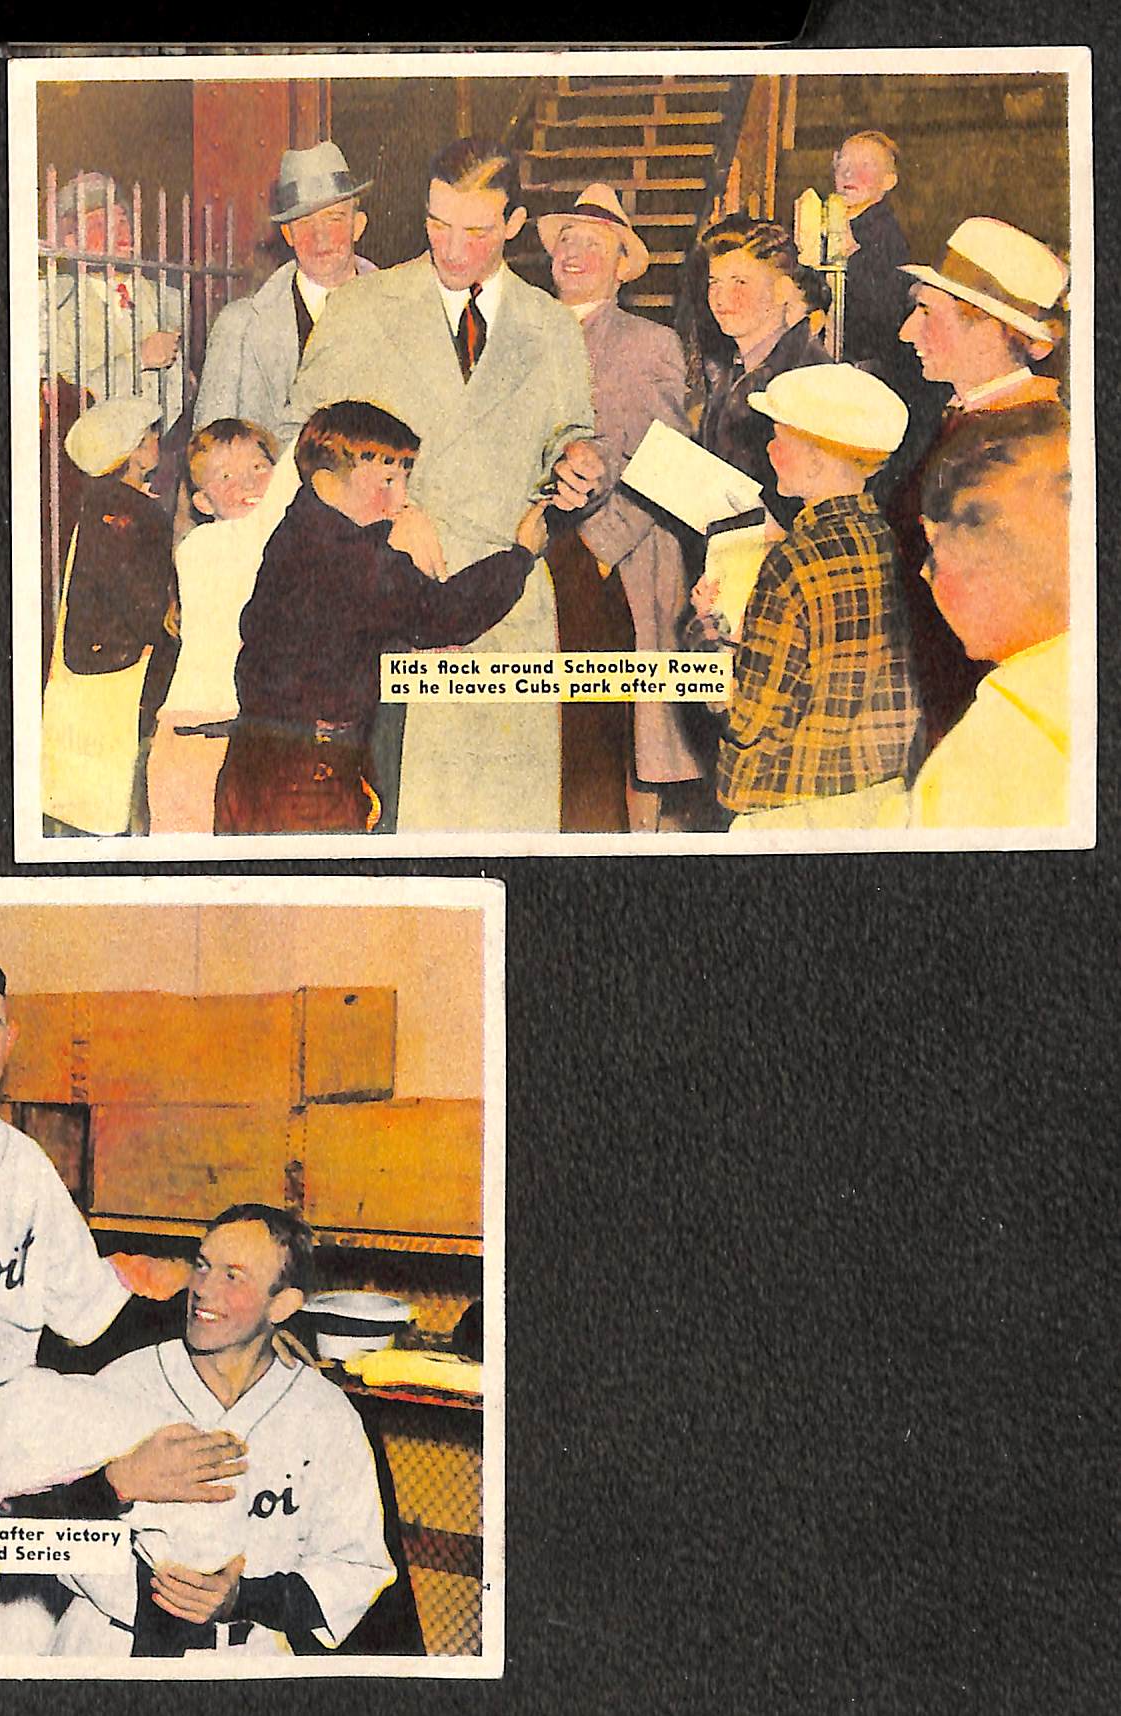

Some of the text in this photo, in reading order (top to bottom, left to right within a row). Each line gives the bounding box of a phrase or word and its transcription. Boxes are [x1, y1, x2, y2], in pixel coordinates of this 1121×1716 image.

[390, 659, 725, 677] Kids flock around Schoolboy Rowe,
[391, 678, 725, 698] as he leaves Cubs park after game
[55, 1527, 121, 1546] victory
[15, 1546, 72, 1562] Series
